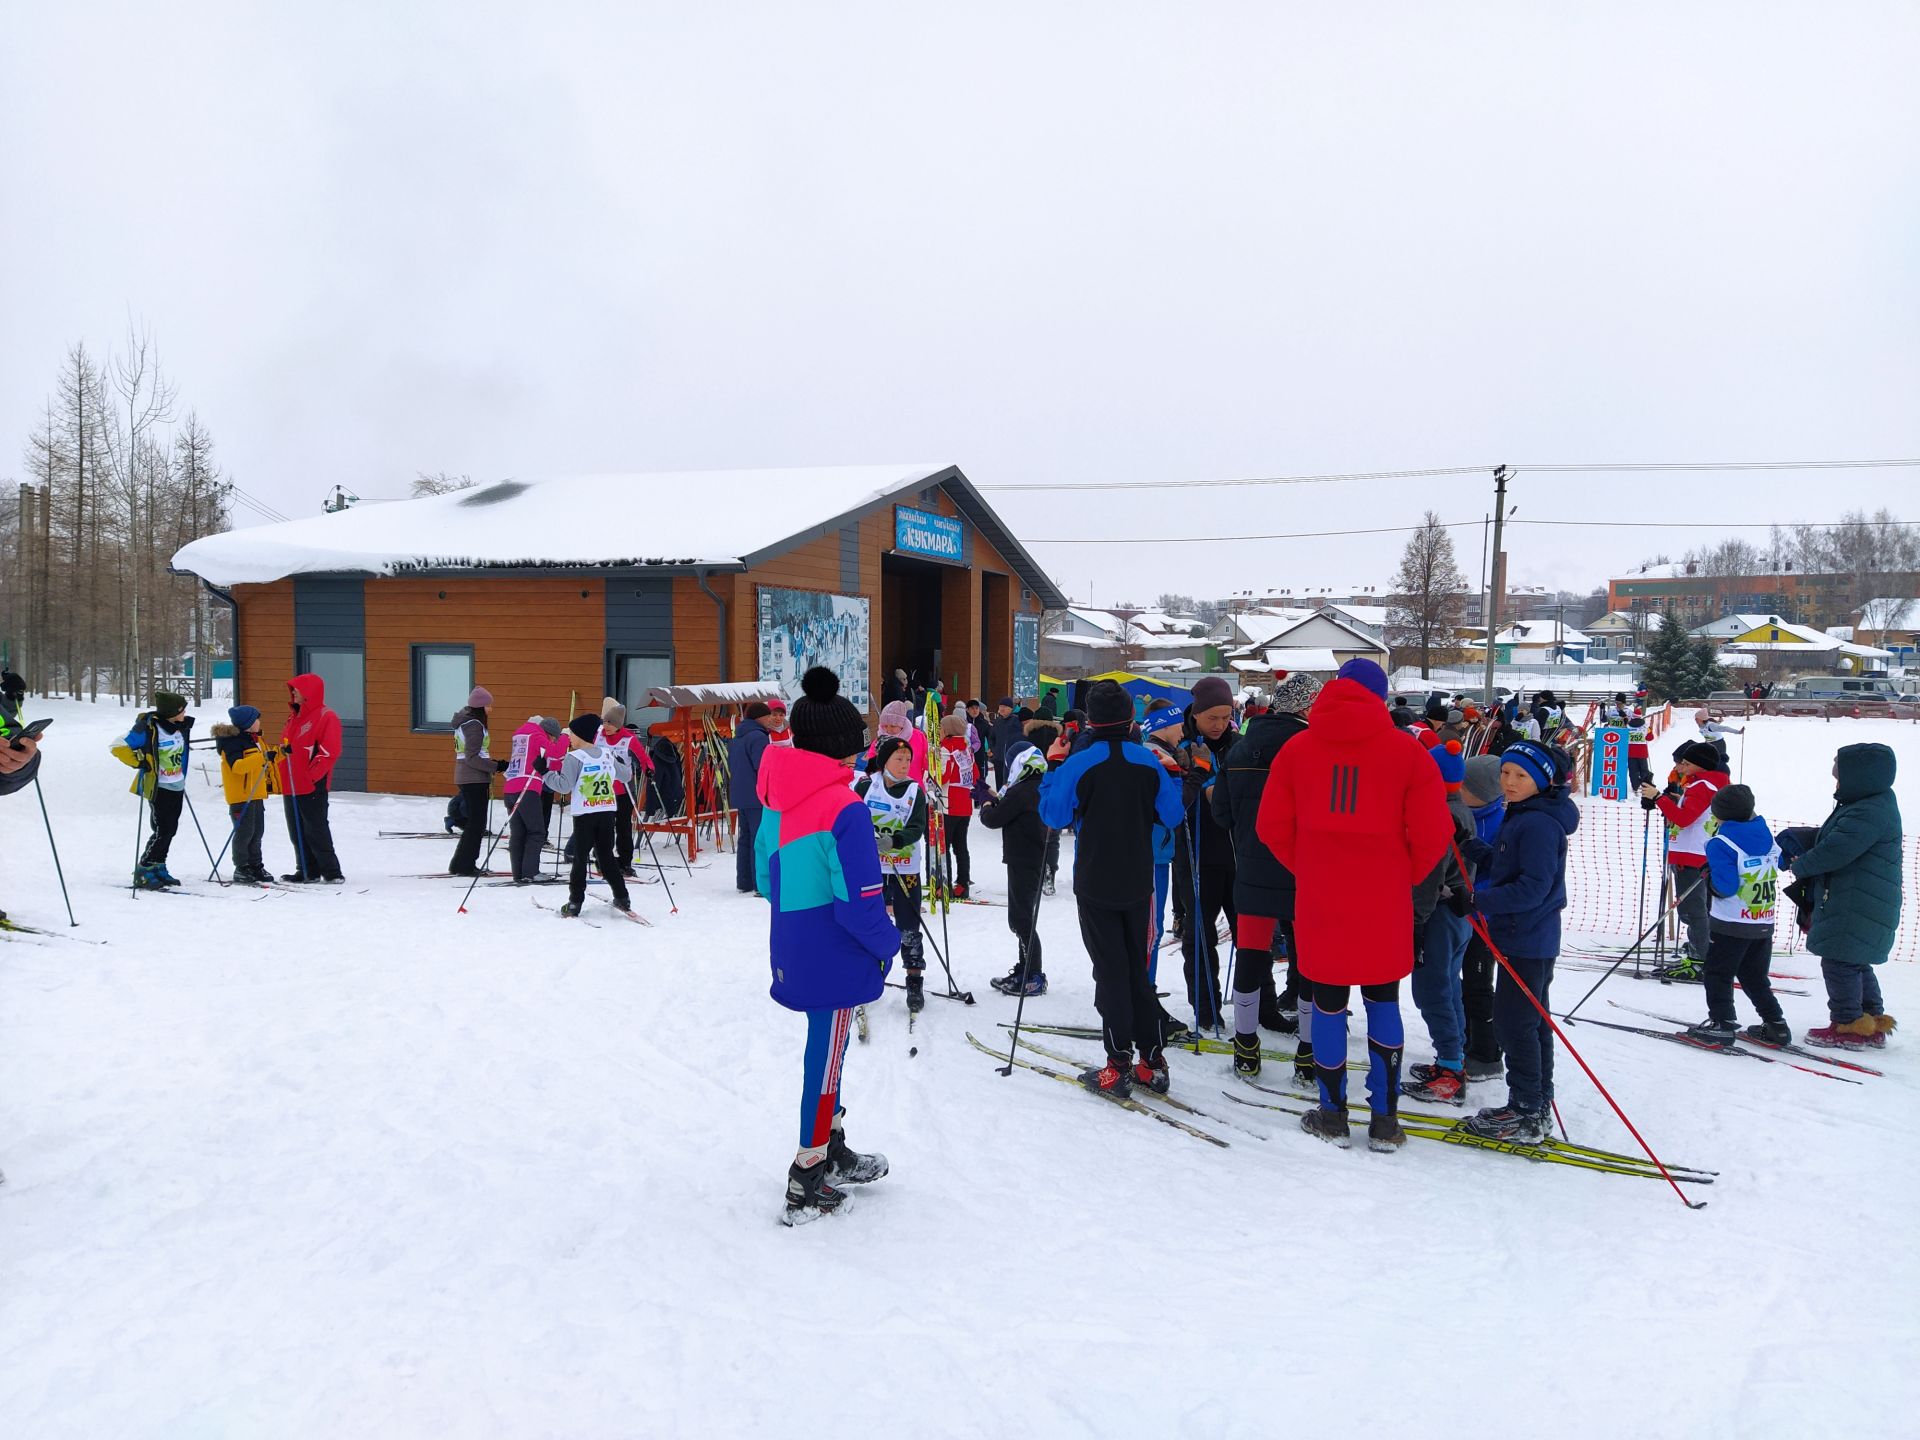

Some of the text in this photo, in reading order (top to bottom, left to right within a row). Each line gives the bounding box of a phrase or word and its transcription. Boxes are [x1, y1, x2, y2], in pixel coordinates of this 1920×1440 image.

[1630, 734, 1643, 742] 252
[1599, 731, 1620, 801] ФИНИШ
[592, 780, 610, 796] 23
[1751, 879, 1777, 905] 245
[1442, 1133, 1549, 1160] FISCHER
